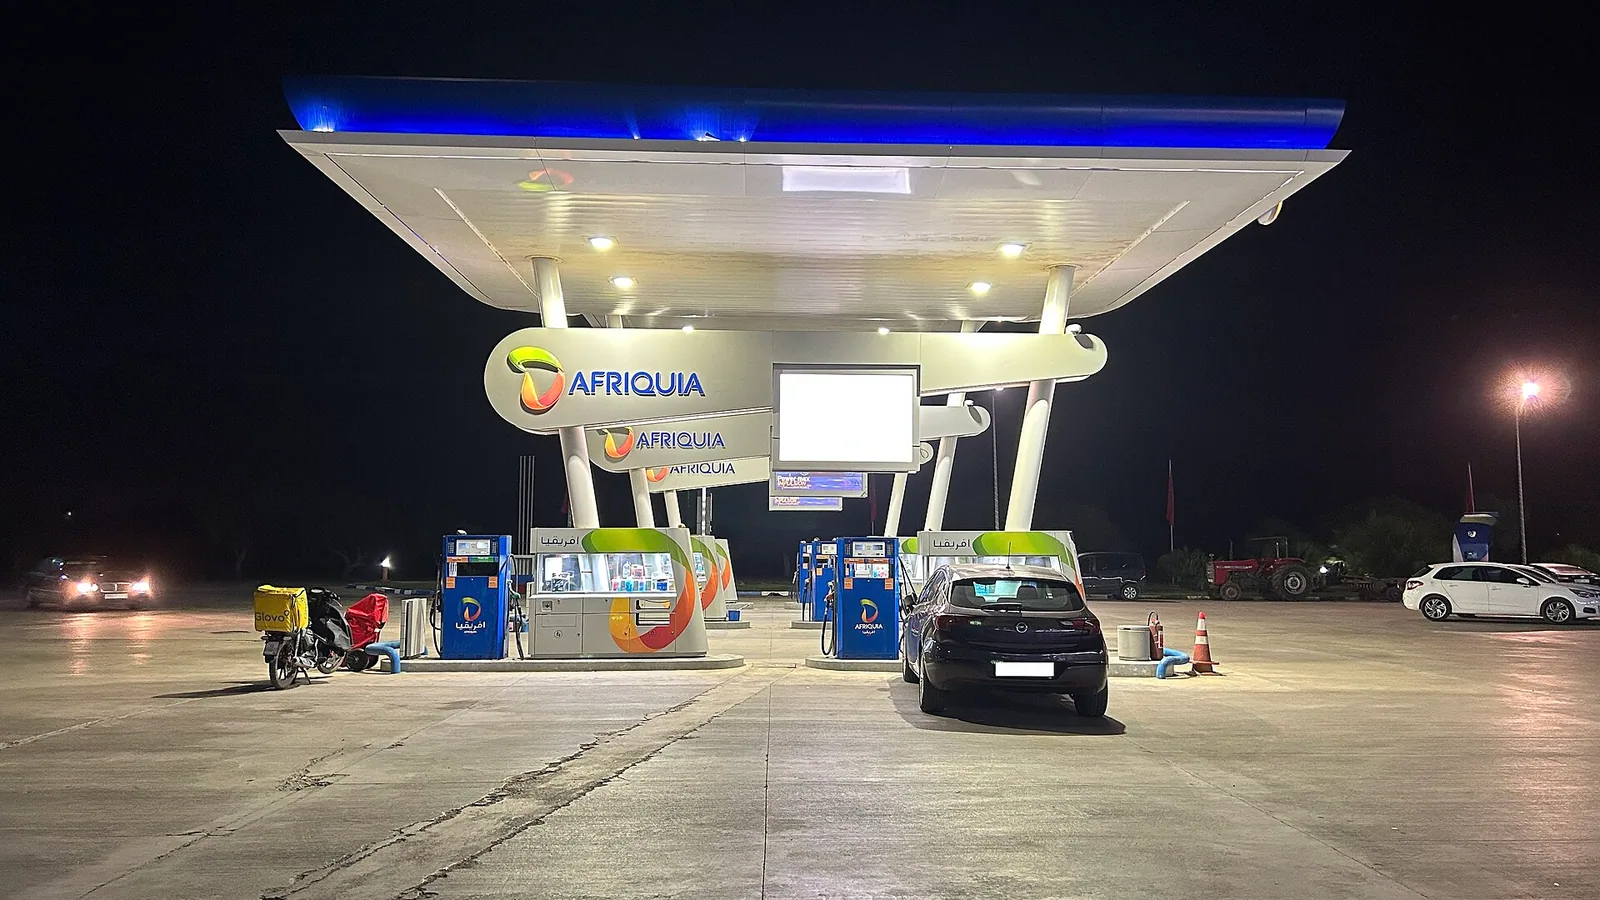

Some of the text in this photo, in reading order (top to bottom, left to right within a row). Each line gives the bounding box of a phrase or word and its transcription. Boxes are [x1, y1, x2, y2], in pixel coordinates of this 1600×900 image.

[568, 371, 706, 396] AFRIQUIA
[636, 431, 726, 450] AFRIQUIA
[669, 463, 736, 474] AFRIQUIA
[255, 611, 287, 622] Glovo
